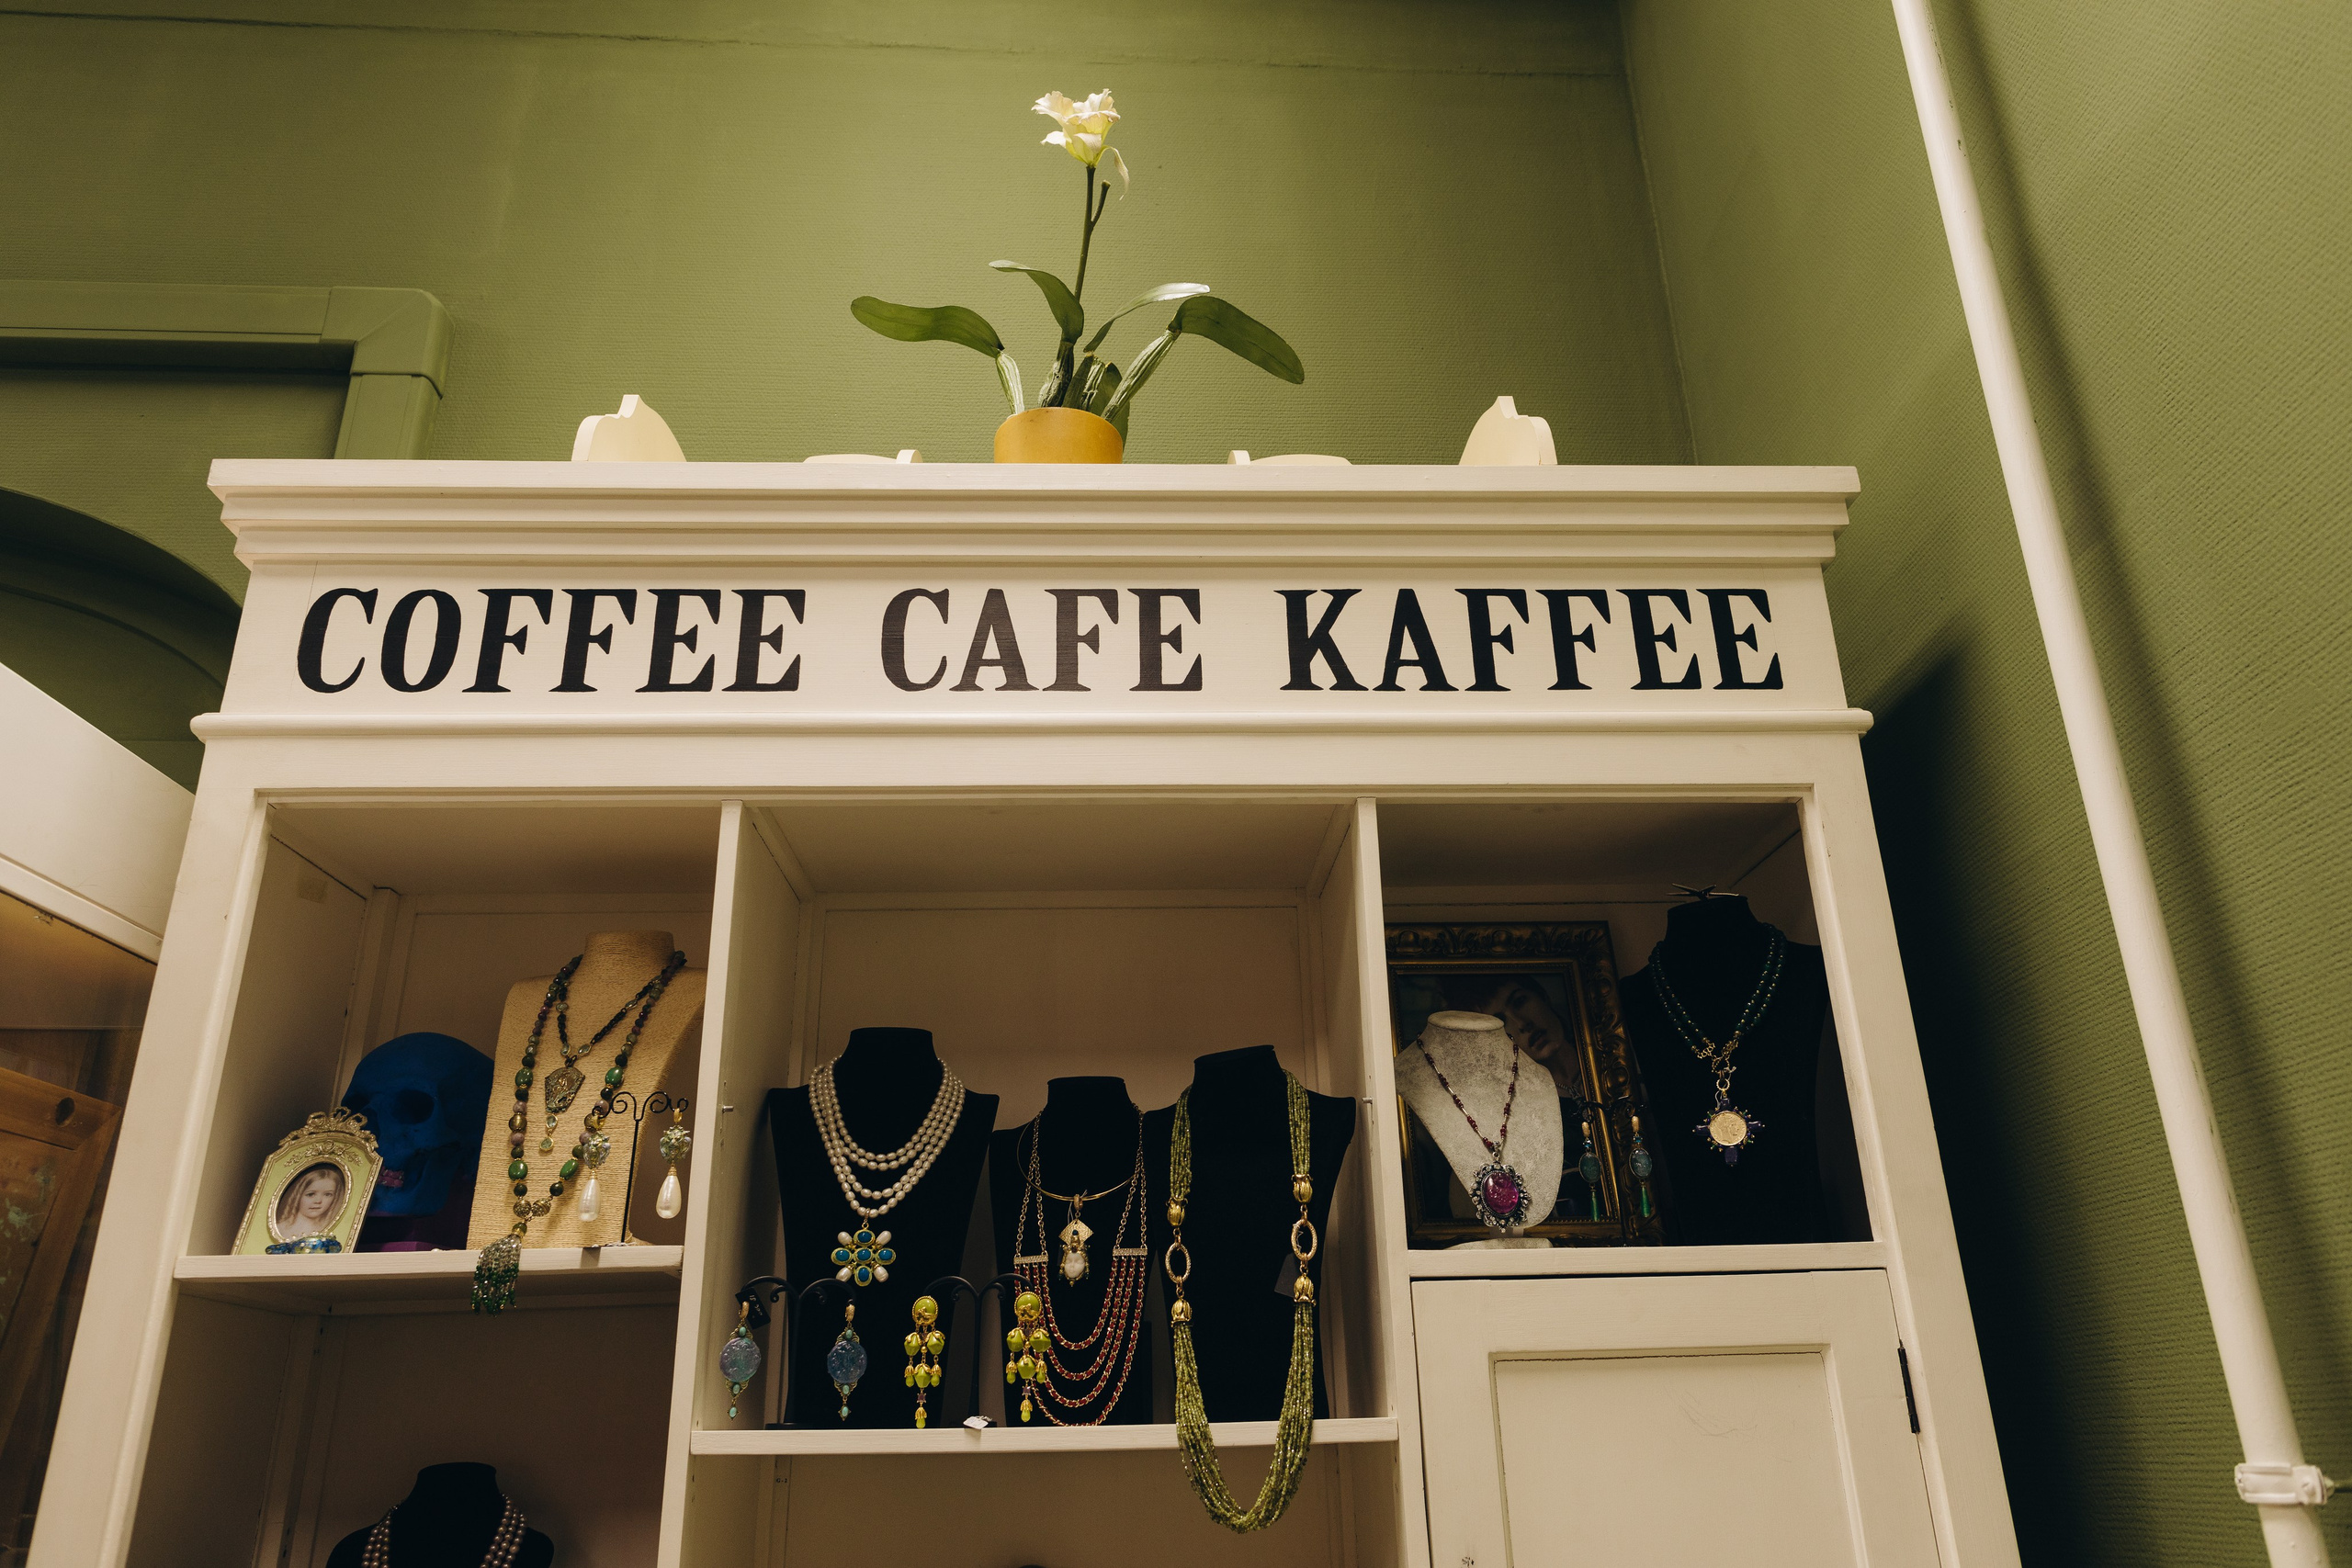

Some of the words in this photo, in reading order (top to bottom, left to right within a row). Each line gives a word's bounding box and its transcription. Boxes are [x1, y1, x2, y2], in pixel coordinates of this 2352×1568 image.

[297, 587, 807, 694] COFFEE
[881, 588, 1203, 693] CAFE
[1273, 588, 1784, 693] KAFFEE
